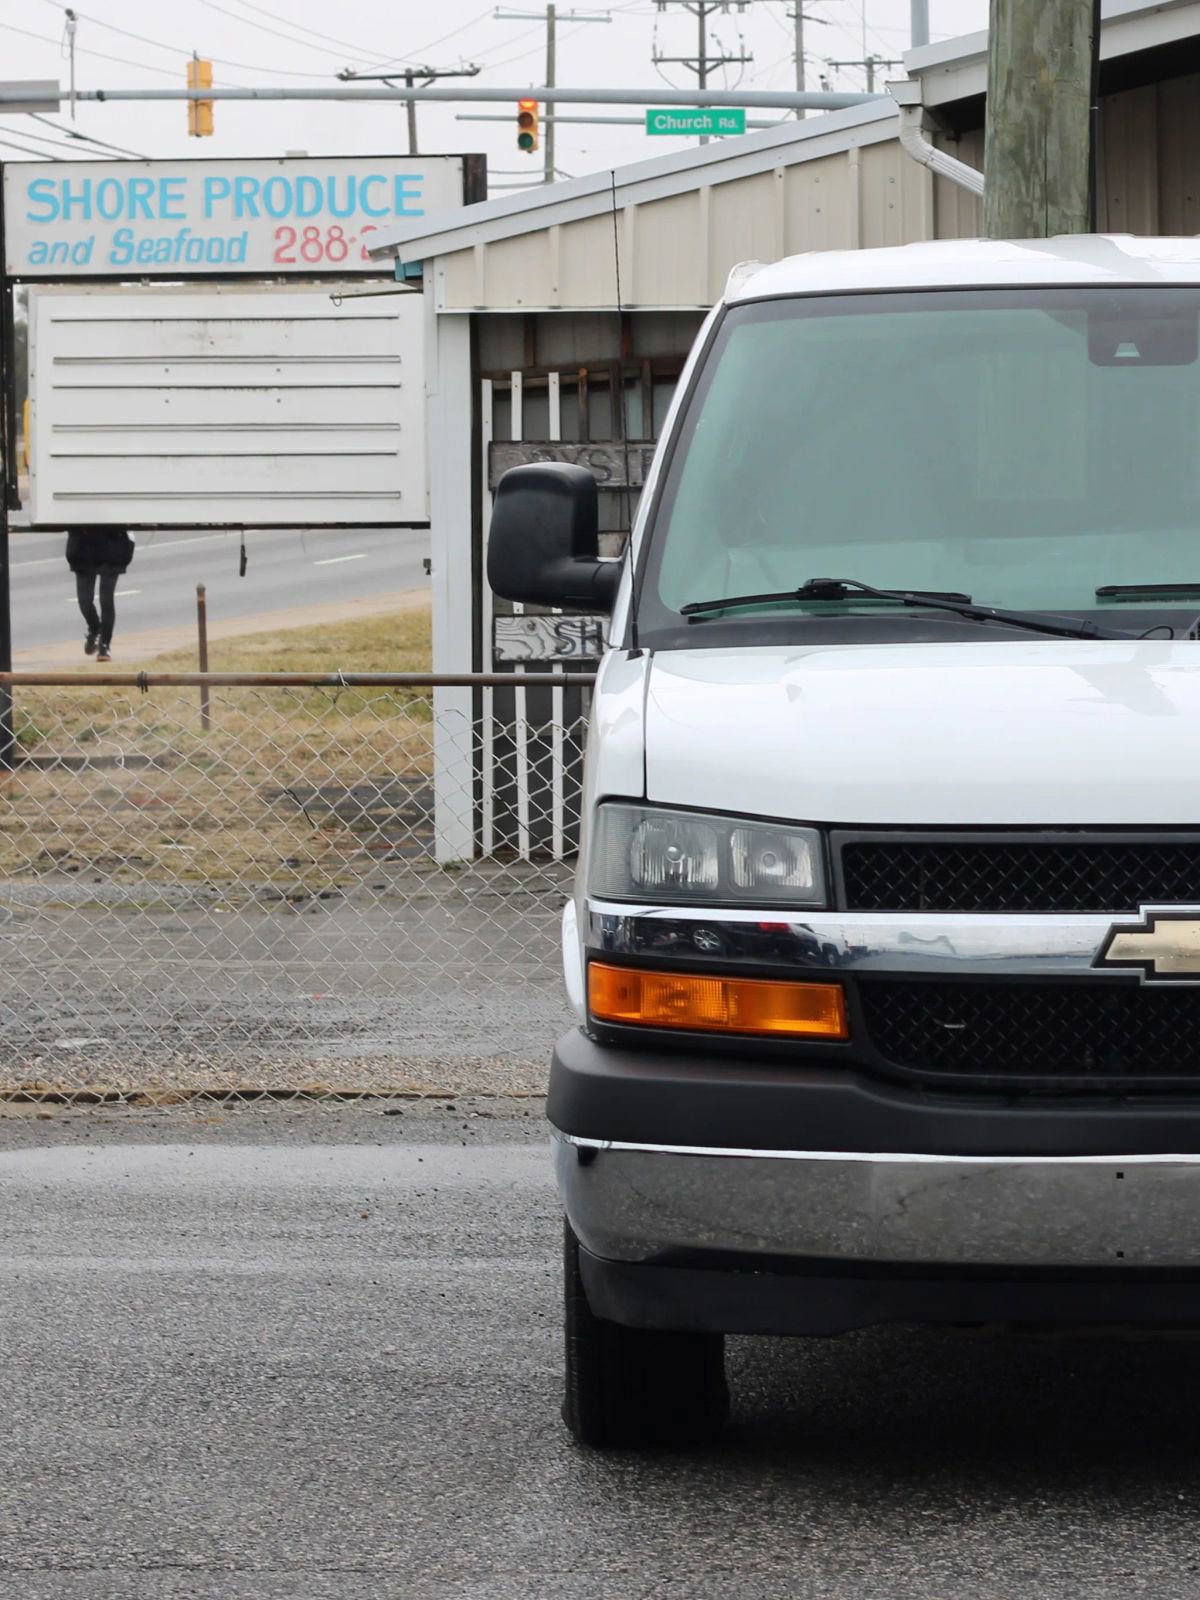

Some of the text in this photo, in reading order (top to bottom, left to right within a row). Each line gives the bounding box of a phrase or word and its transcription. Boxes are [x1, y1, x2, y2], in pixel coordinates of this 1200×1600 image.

[654, 115, 739, 129] Church Rd.
[26, 174, 425, 223] SHORE PRODUCE
[27, 236, 96, 266] and
[109, 226, 249, 266] Seafood
